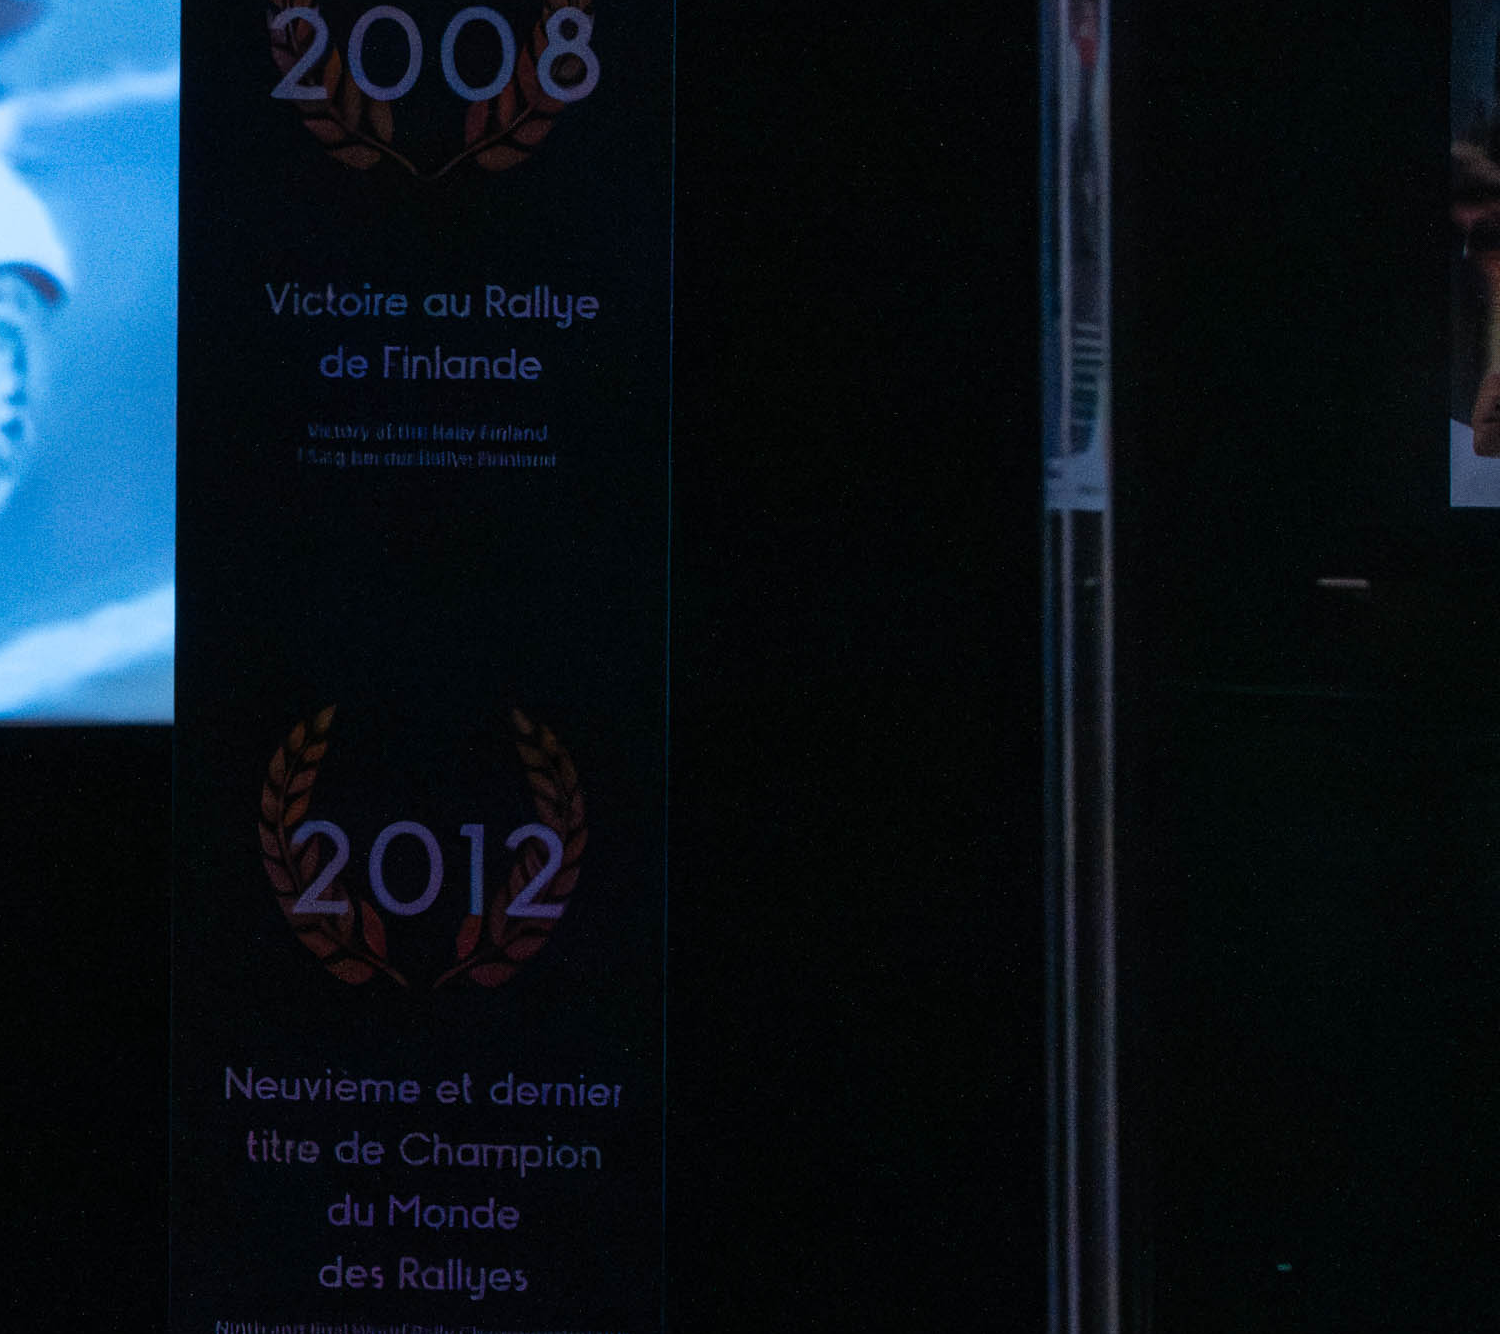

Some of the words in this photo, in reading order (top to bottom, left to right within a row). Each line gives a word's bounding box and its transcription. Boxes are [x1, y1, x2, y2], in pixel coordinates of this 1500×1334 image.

[269, 3, 601, 104] 2008
[265, 282, 409, 318] Victoire
[423, 293, 472, 319] au
[485, 284, 600, 329] Rallye
[319, 345, 369, 379] de
[383, 345, 543, 381] Finlande
[291, 819, 566, 920] 2012
[224, 1066, 421, 1104] Neuvième
[435, 1072, 473, 1104] et
[489, 1071, 622, 1108] dernier
[246, 1129, 321, 1164] titre
[334, 1130, 386, 1166] de
[398, 1131, 602, 1178] Champion
[327, 1193, 375, 1227] du
[387, 1194, 520, 1231] Monde
[317, 1255, 385, 1290] des
[398, 1256, 528, 1301] Rallyes
